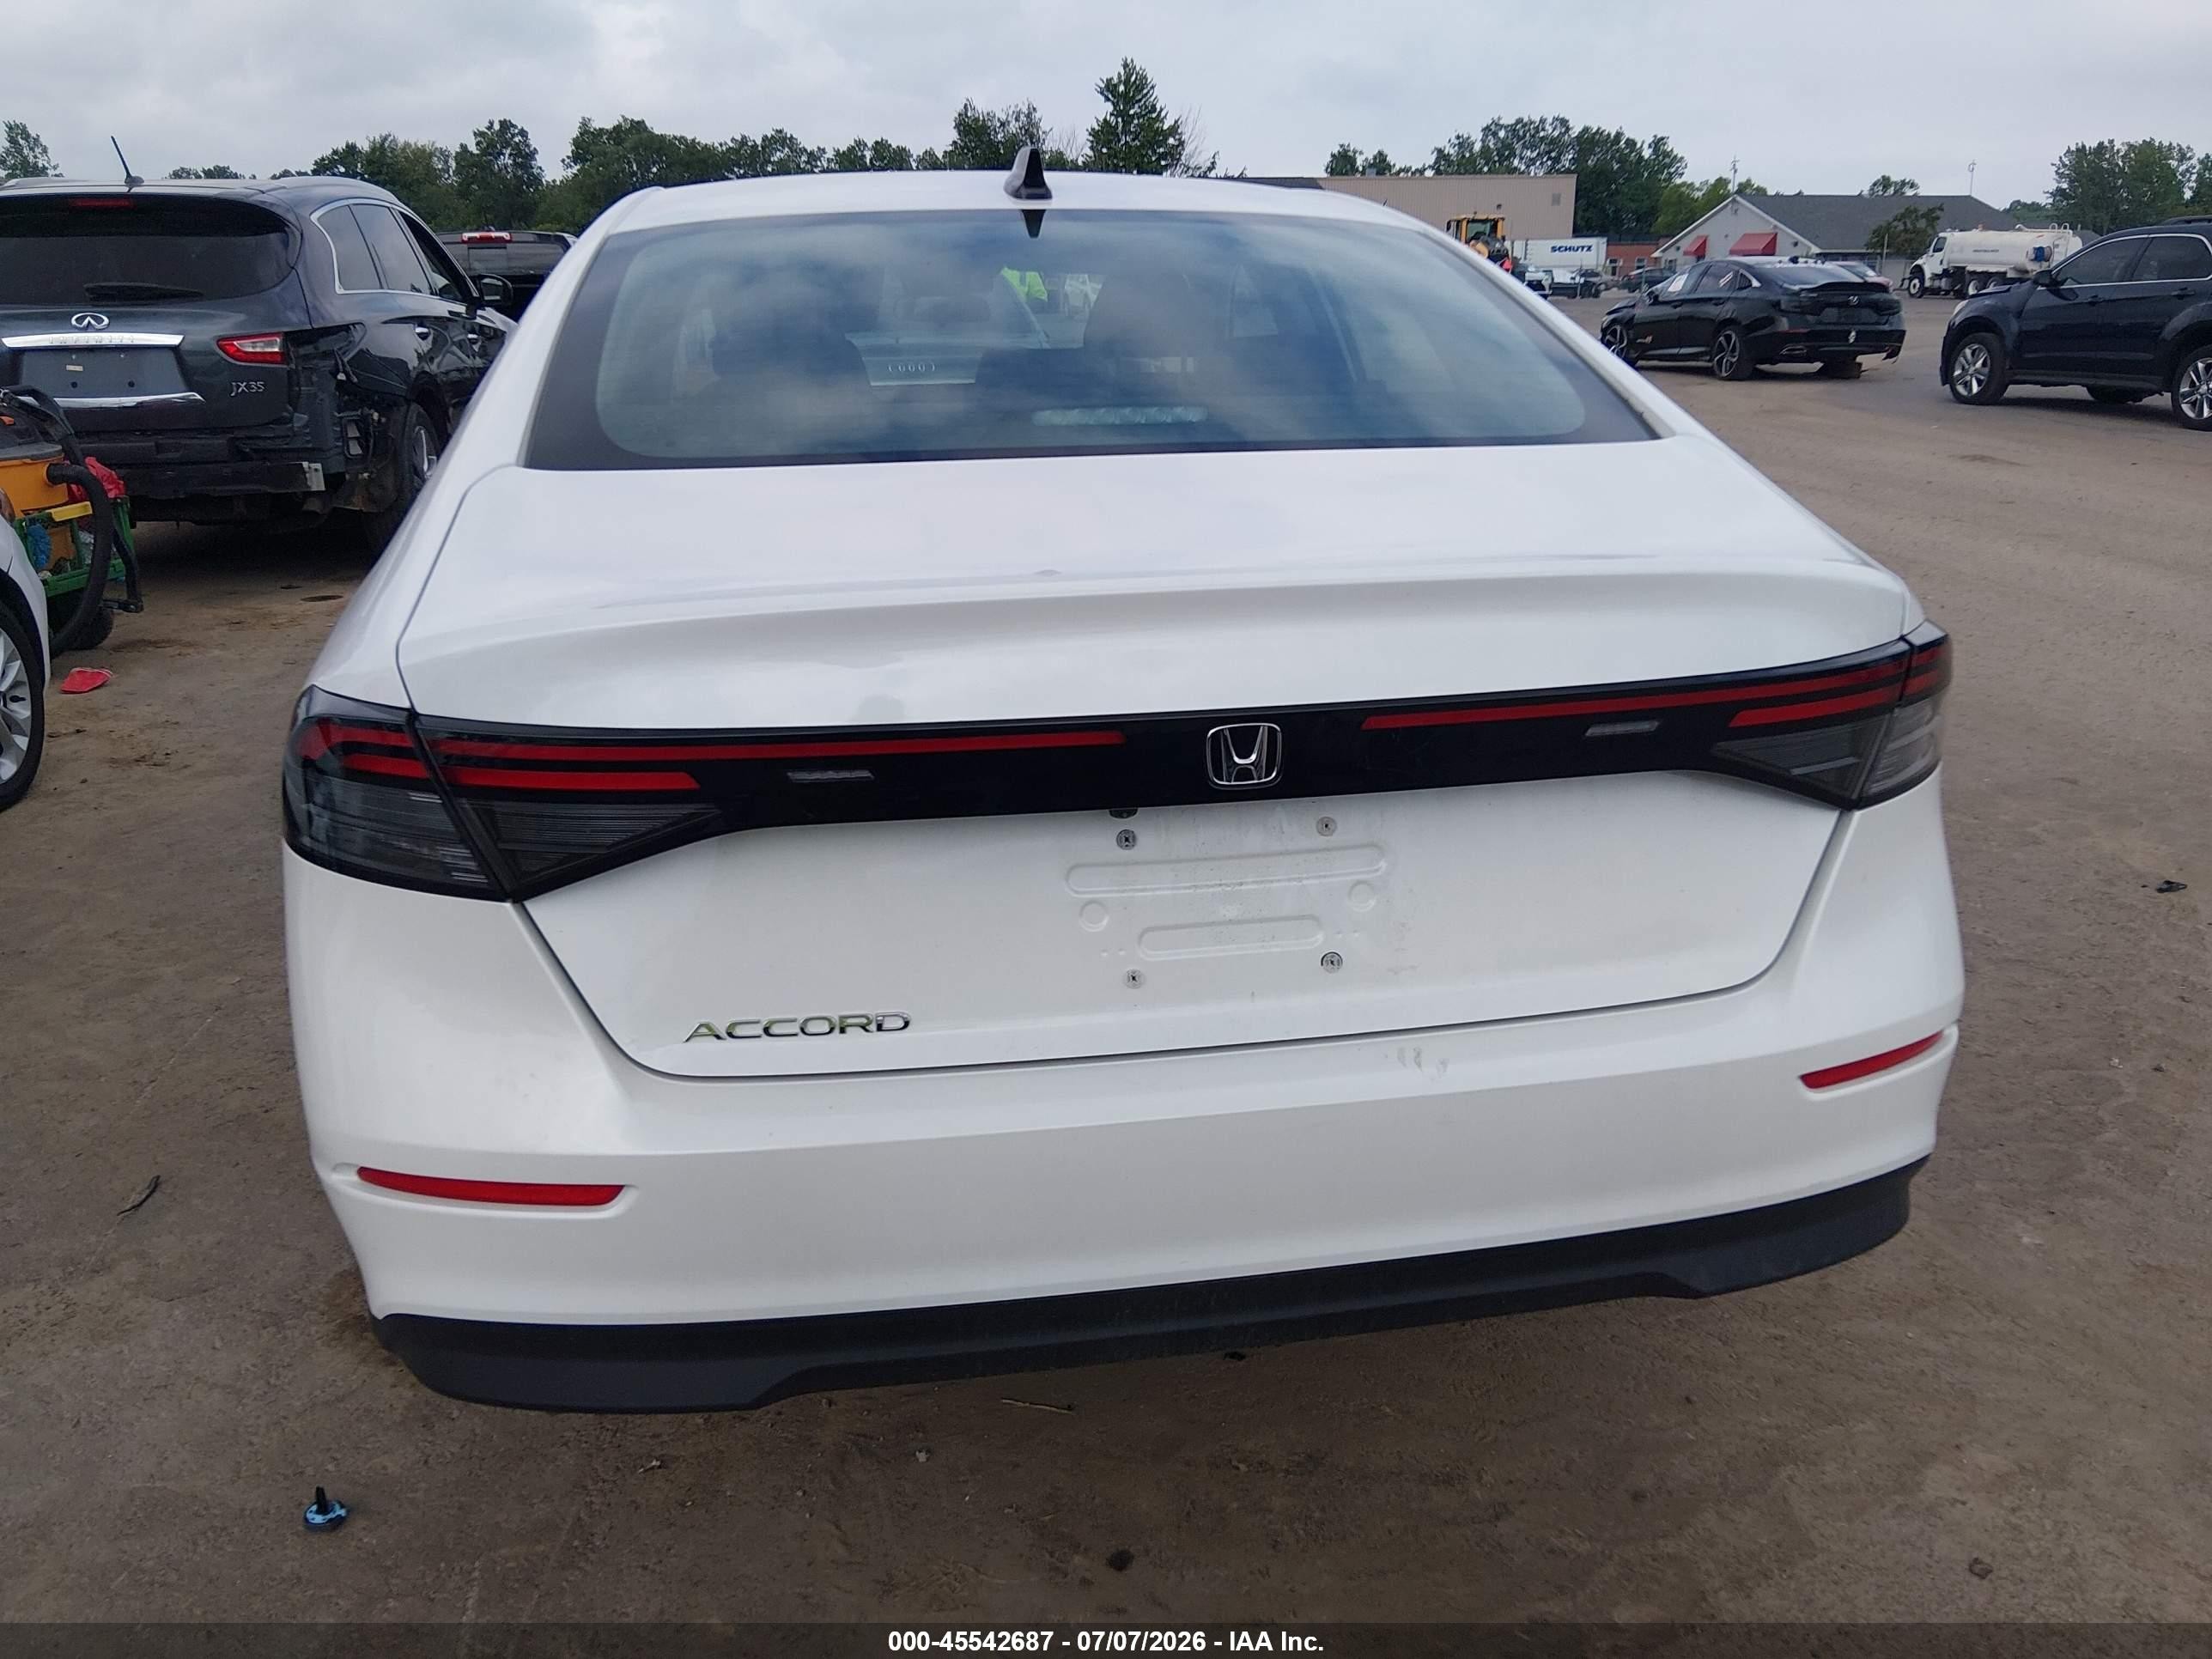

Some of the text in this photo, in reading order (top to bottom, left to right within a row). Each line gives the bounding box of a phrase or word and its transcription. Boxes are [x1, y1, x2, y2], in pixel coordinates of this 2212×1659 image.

[1550, 245, 1593, 253] SCHUTZ
[230, 381, 265, 397] JX35
[684, 1011, 913, 1043] ACCORD
